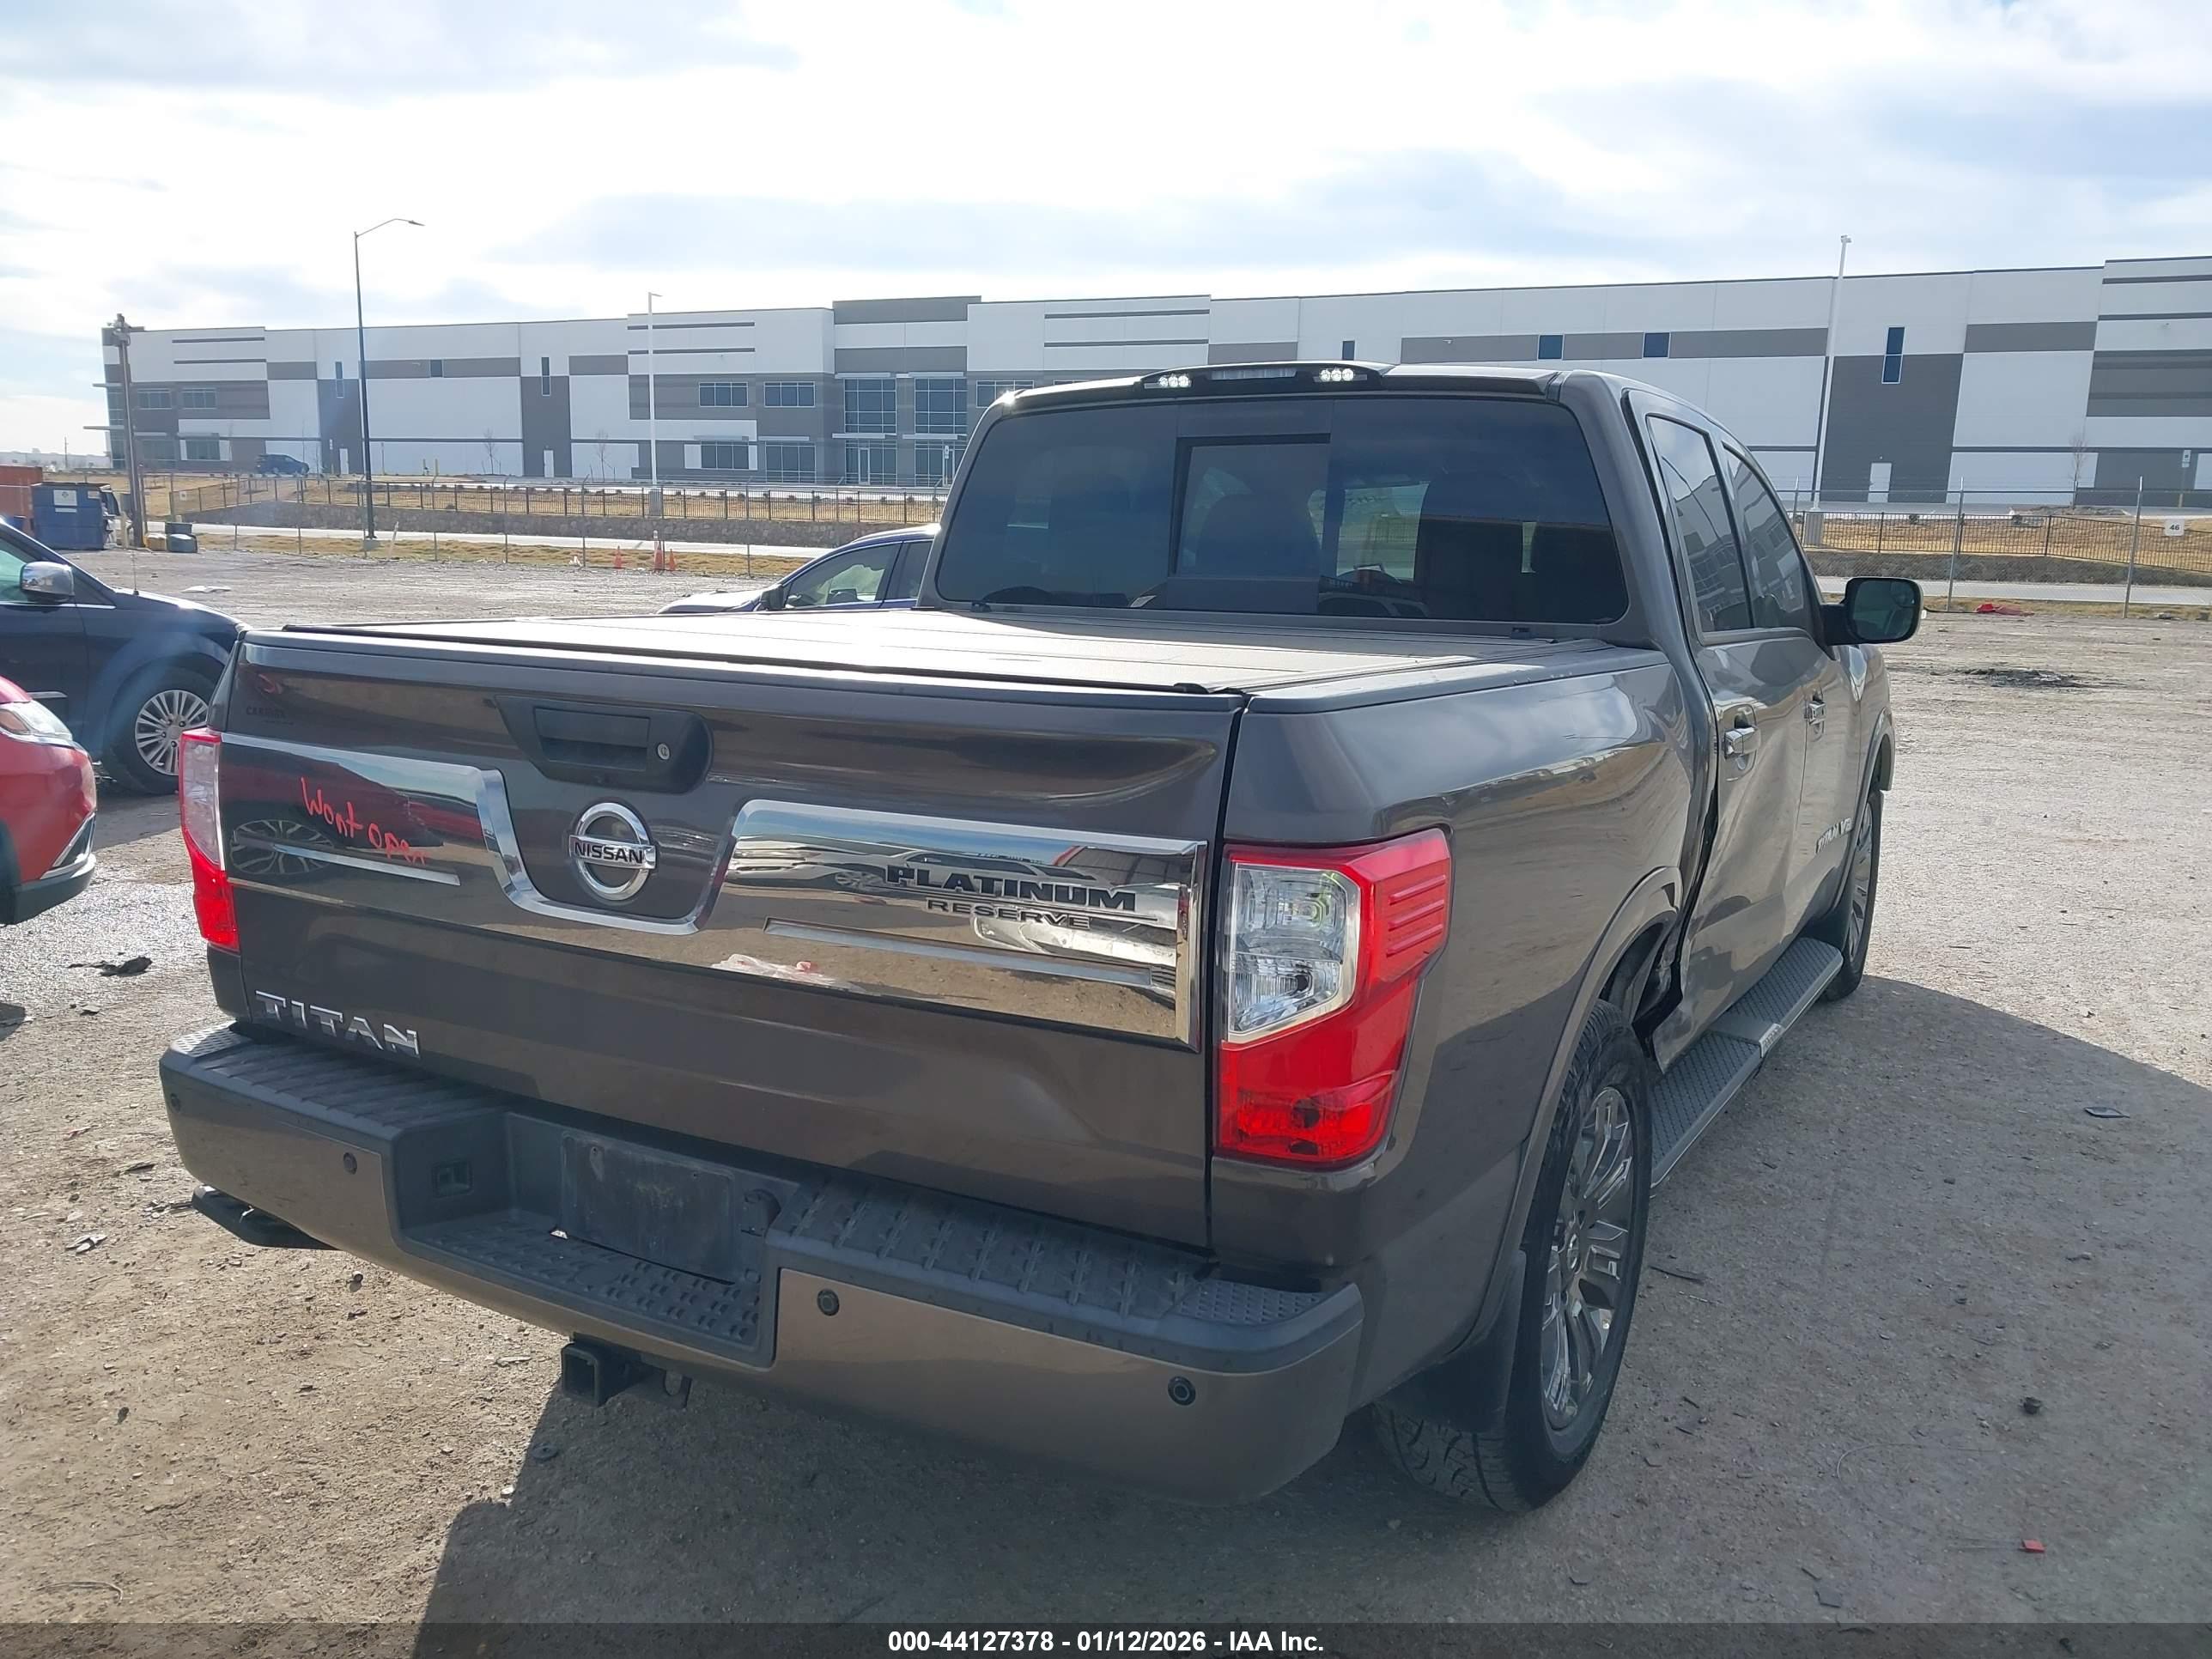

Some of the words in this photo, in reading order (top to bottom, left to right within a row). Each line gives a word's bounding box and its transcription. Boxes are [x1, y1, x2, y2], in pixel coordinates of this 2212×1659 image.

[574, 842, 643, 864] NISSAN
[885, 865, 1136, 912] PLATINUM
[927, 898, 1091, 930] RESERVE
[256, 990, 420, 1060] TITAN
